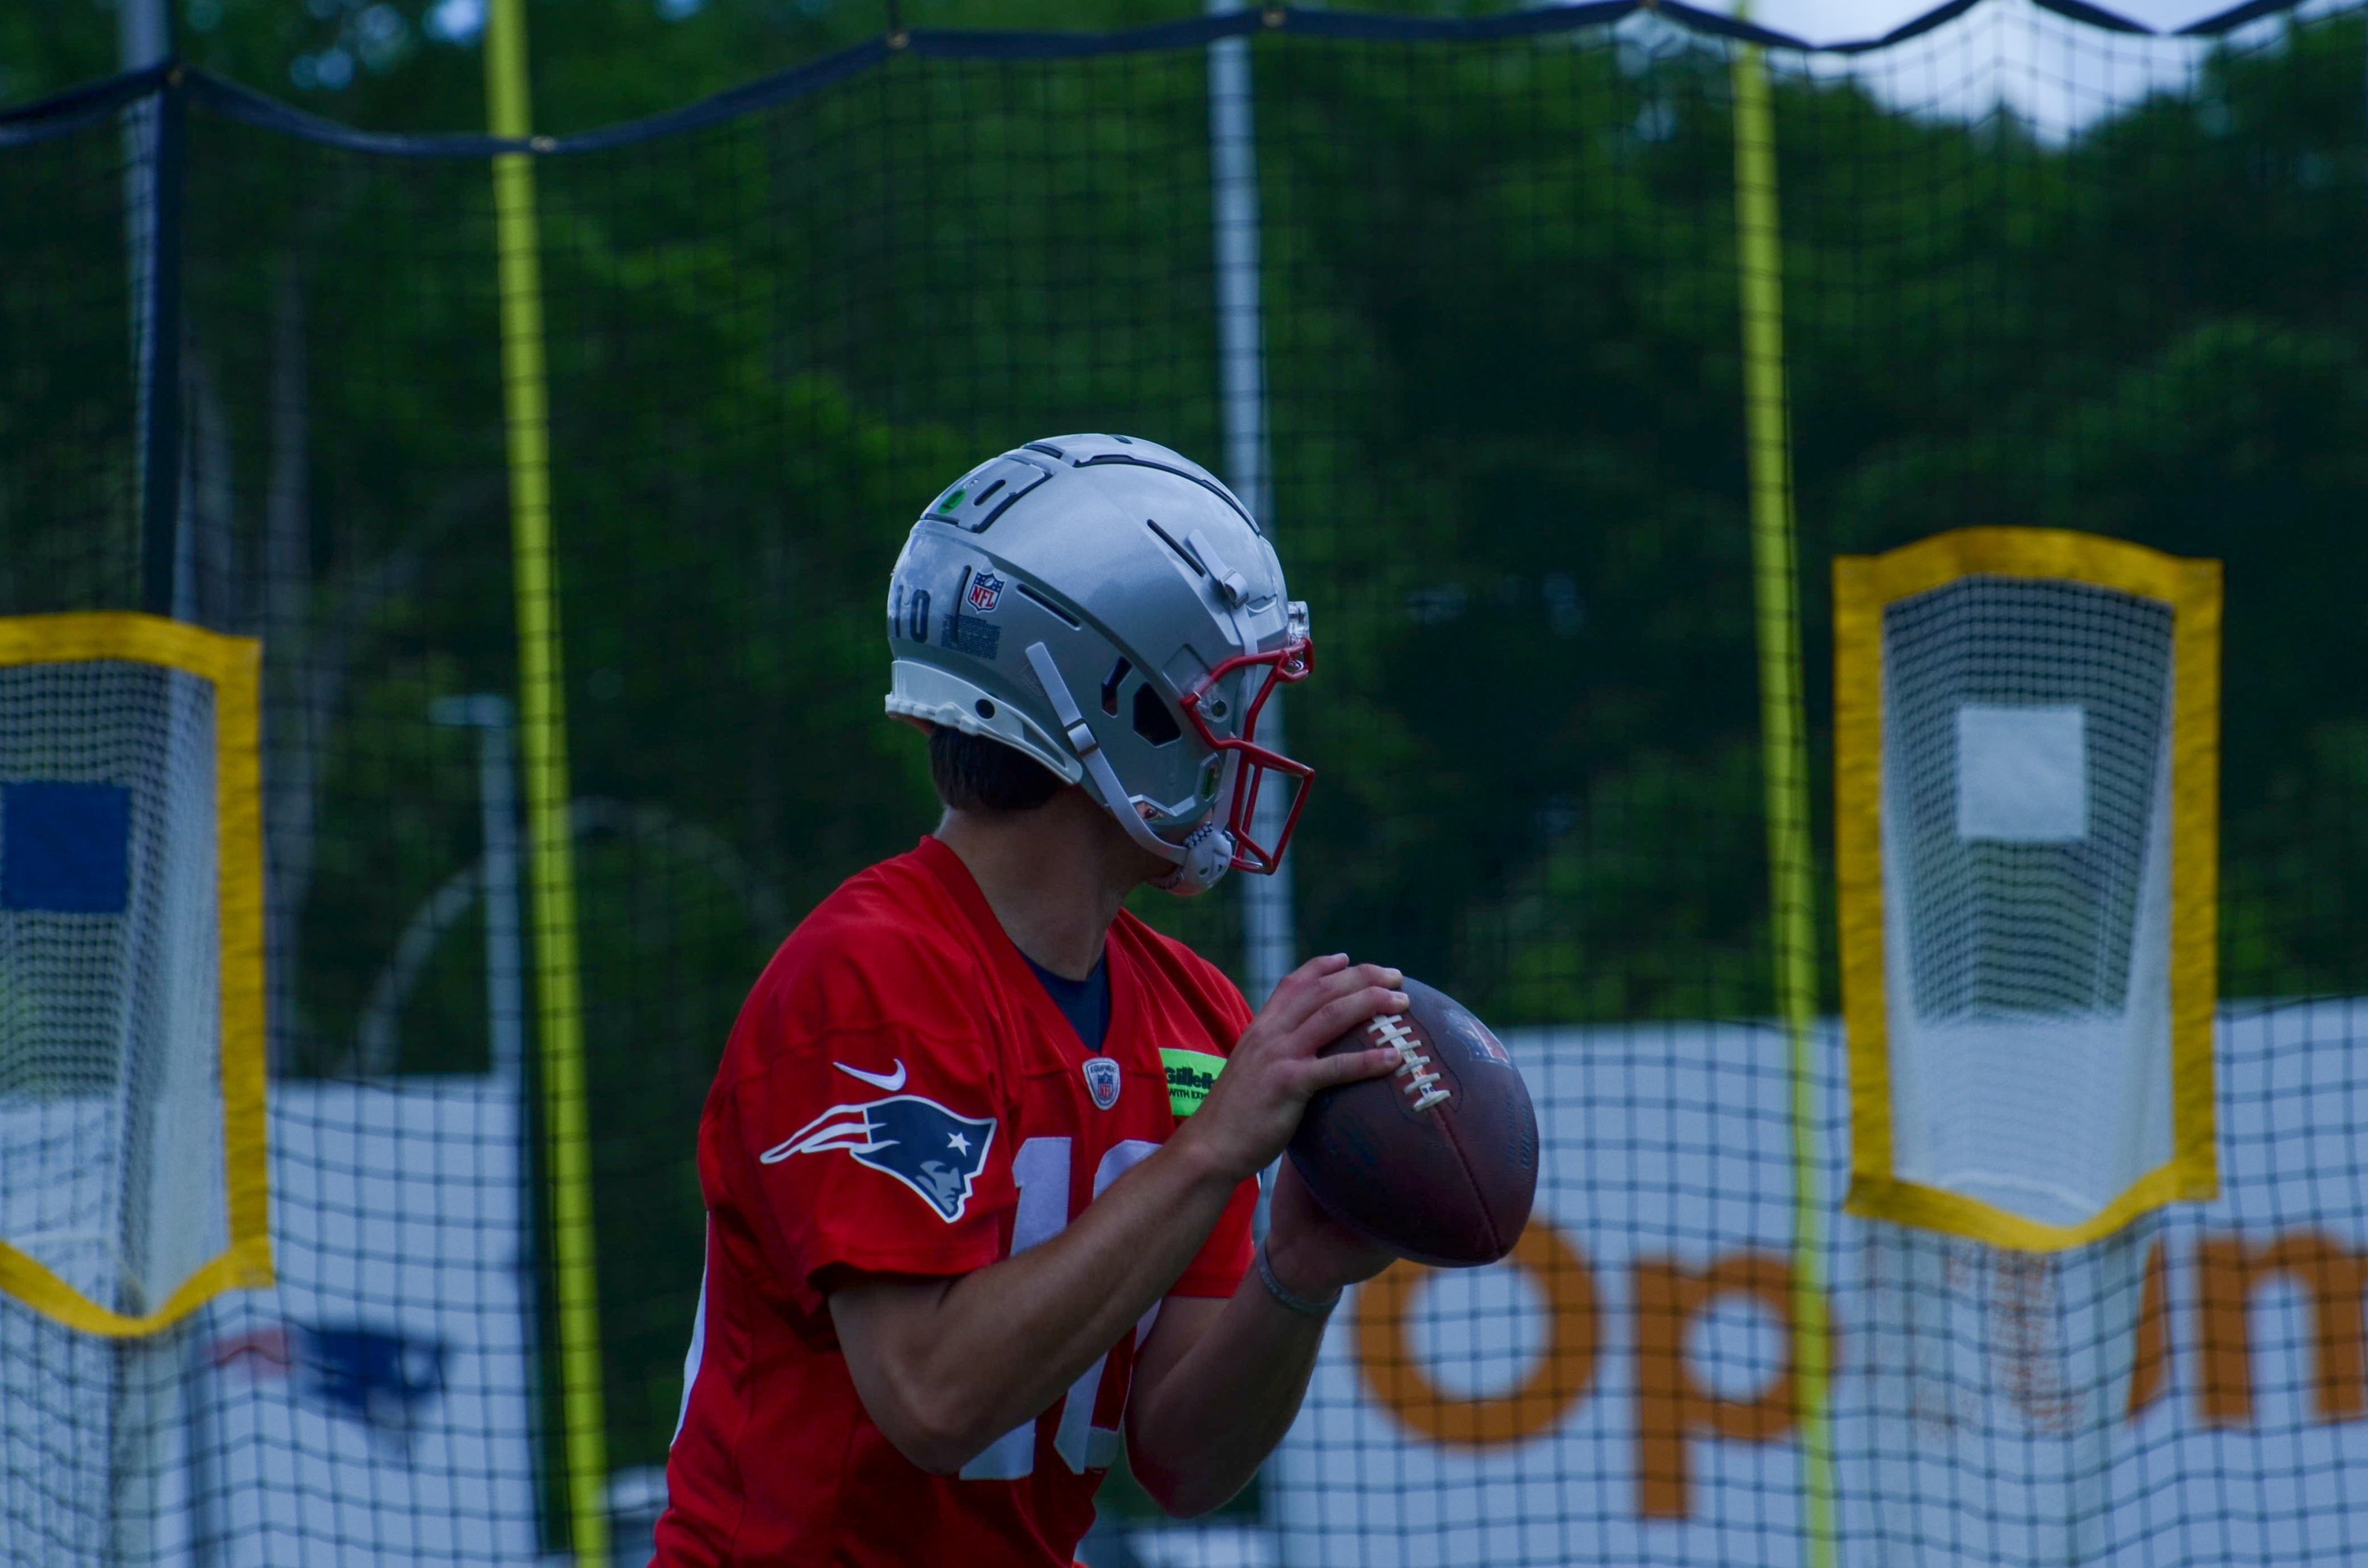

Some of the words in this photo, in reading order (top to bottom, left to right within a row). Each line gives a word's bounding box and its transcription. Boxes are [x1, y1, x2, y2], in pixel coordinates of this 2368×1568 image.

[969, 586, 996, 607] NFL
[894, 584, 931, 643] 10
[1165, 1066, 1214, 1089] Gillett
